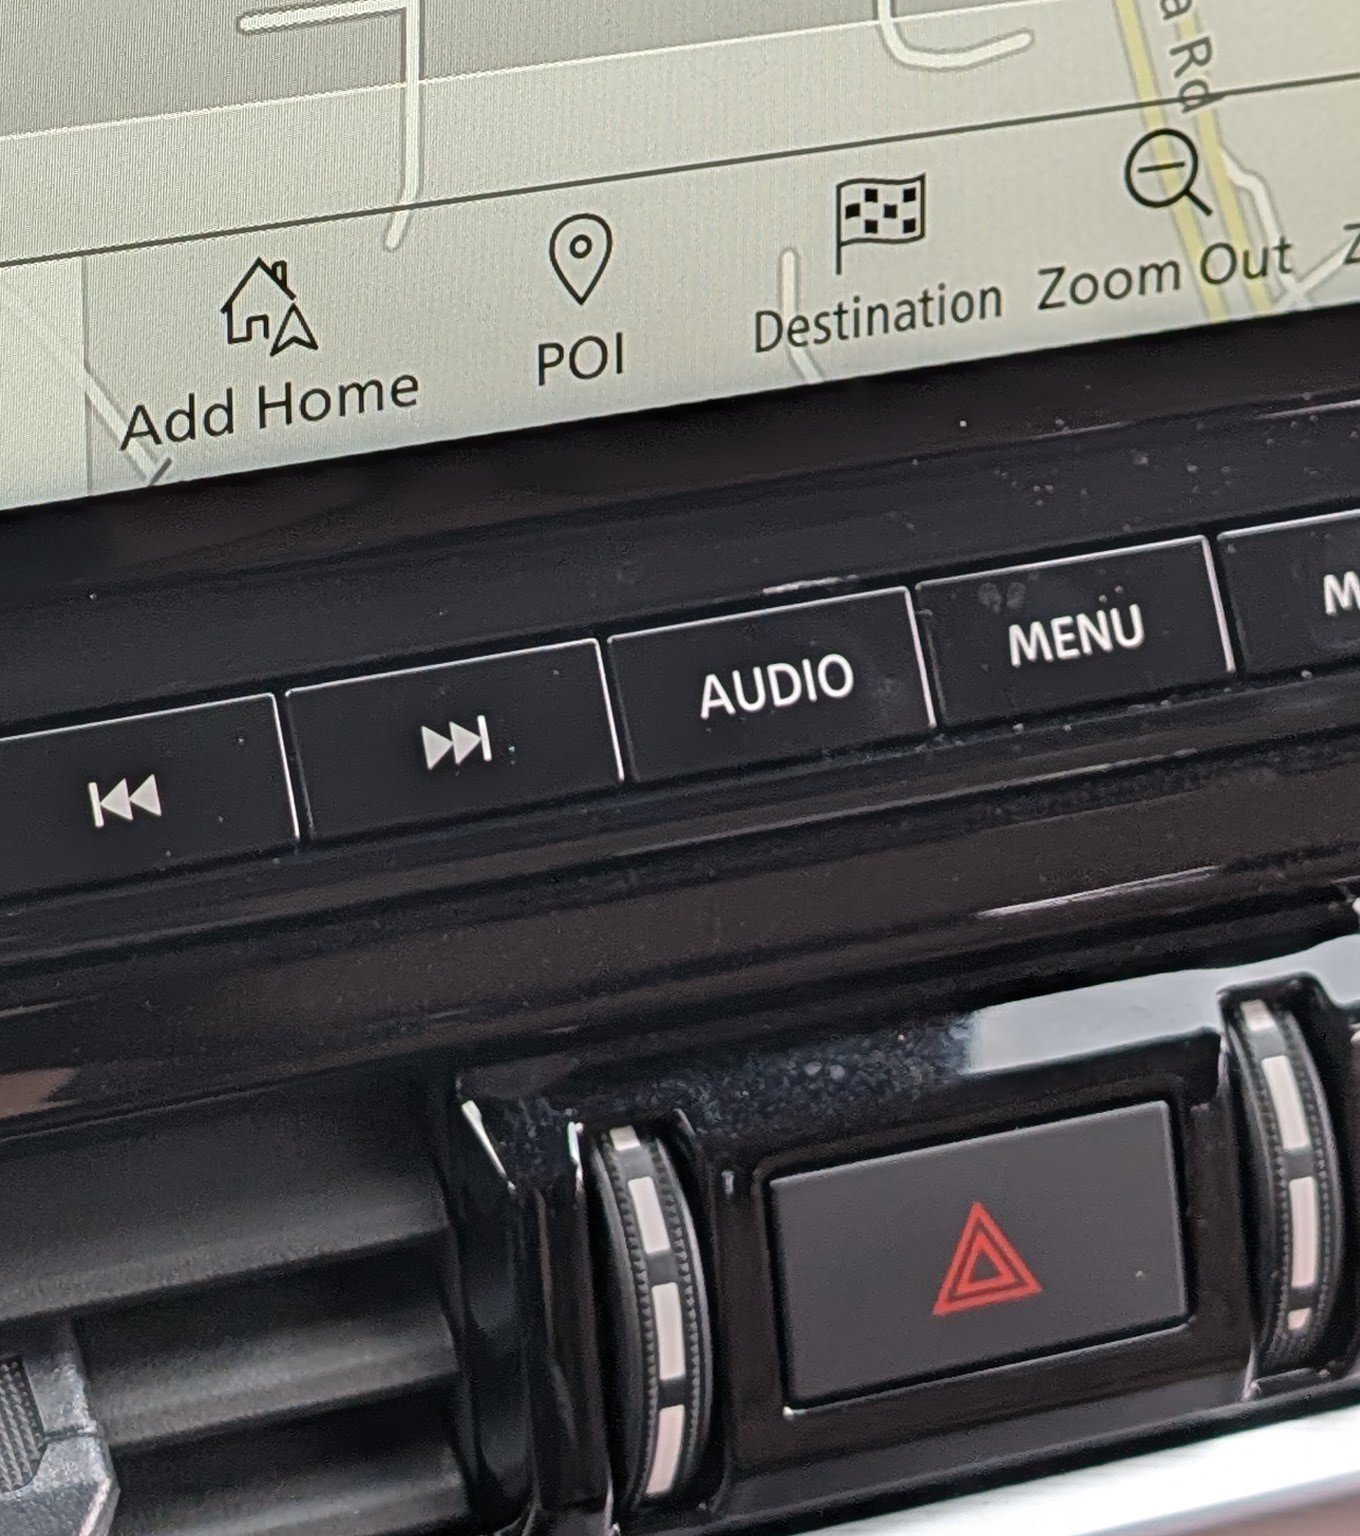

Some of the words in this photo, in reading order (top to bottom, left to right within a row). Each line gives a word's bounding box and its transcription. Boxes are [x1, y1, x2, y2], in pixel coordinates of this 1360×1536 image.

[1169, 36, 1223, 114] Rd
[1036, 260, 1181, 312] Zoom
[1199, 237, 1294, 284] Out
[754, 278, 1004, 355] Destination
[536, 331, 626, 386] POI
[119, 388, 235, 451] Add
[258, 372, 421, 430] Home
[1008, 603, 1145, 667] MENU
[699, 652, 855, 720] AUDIO
